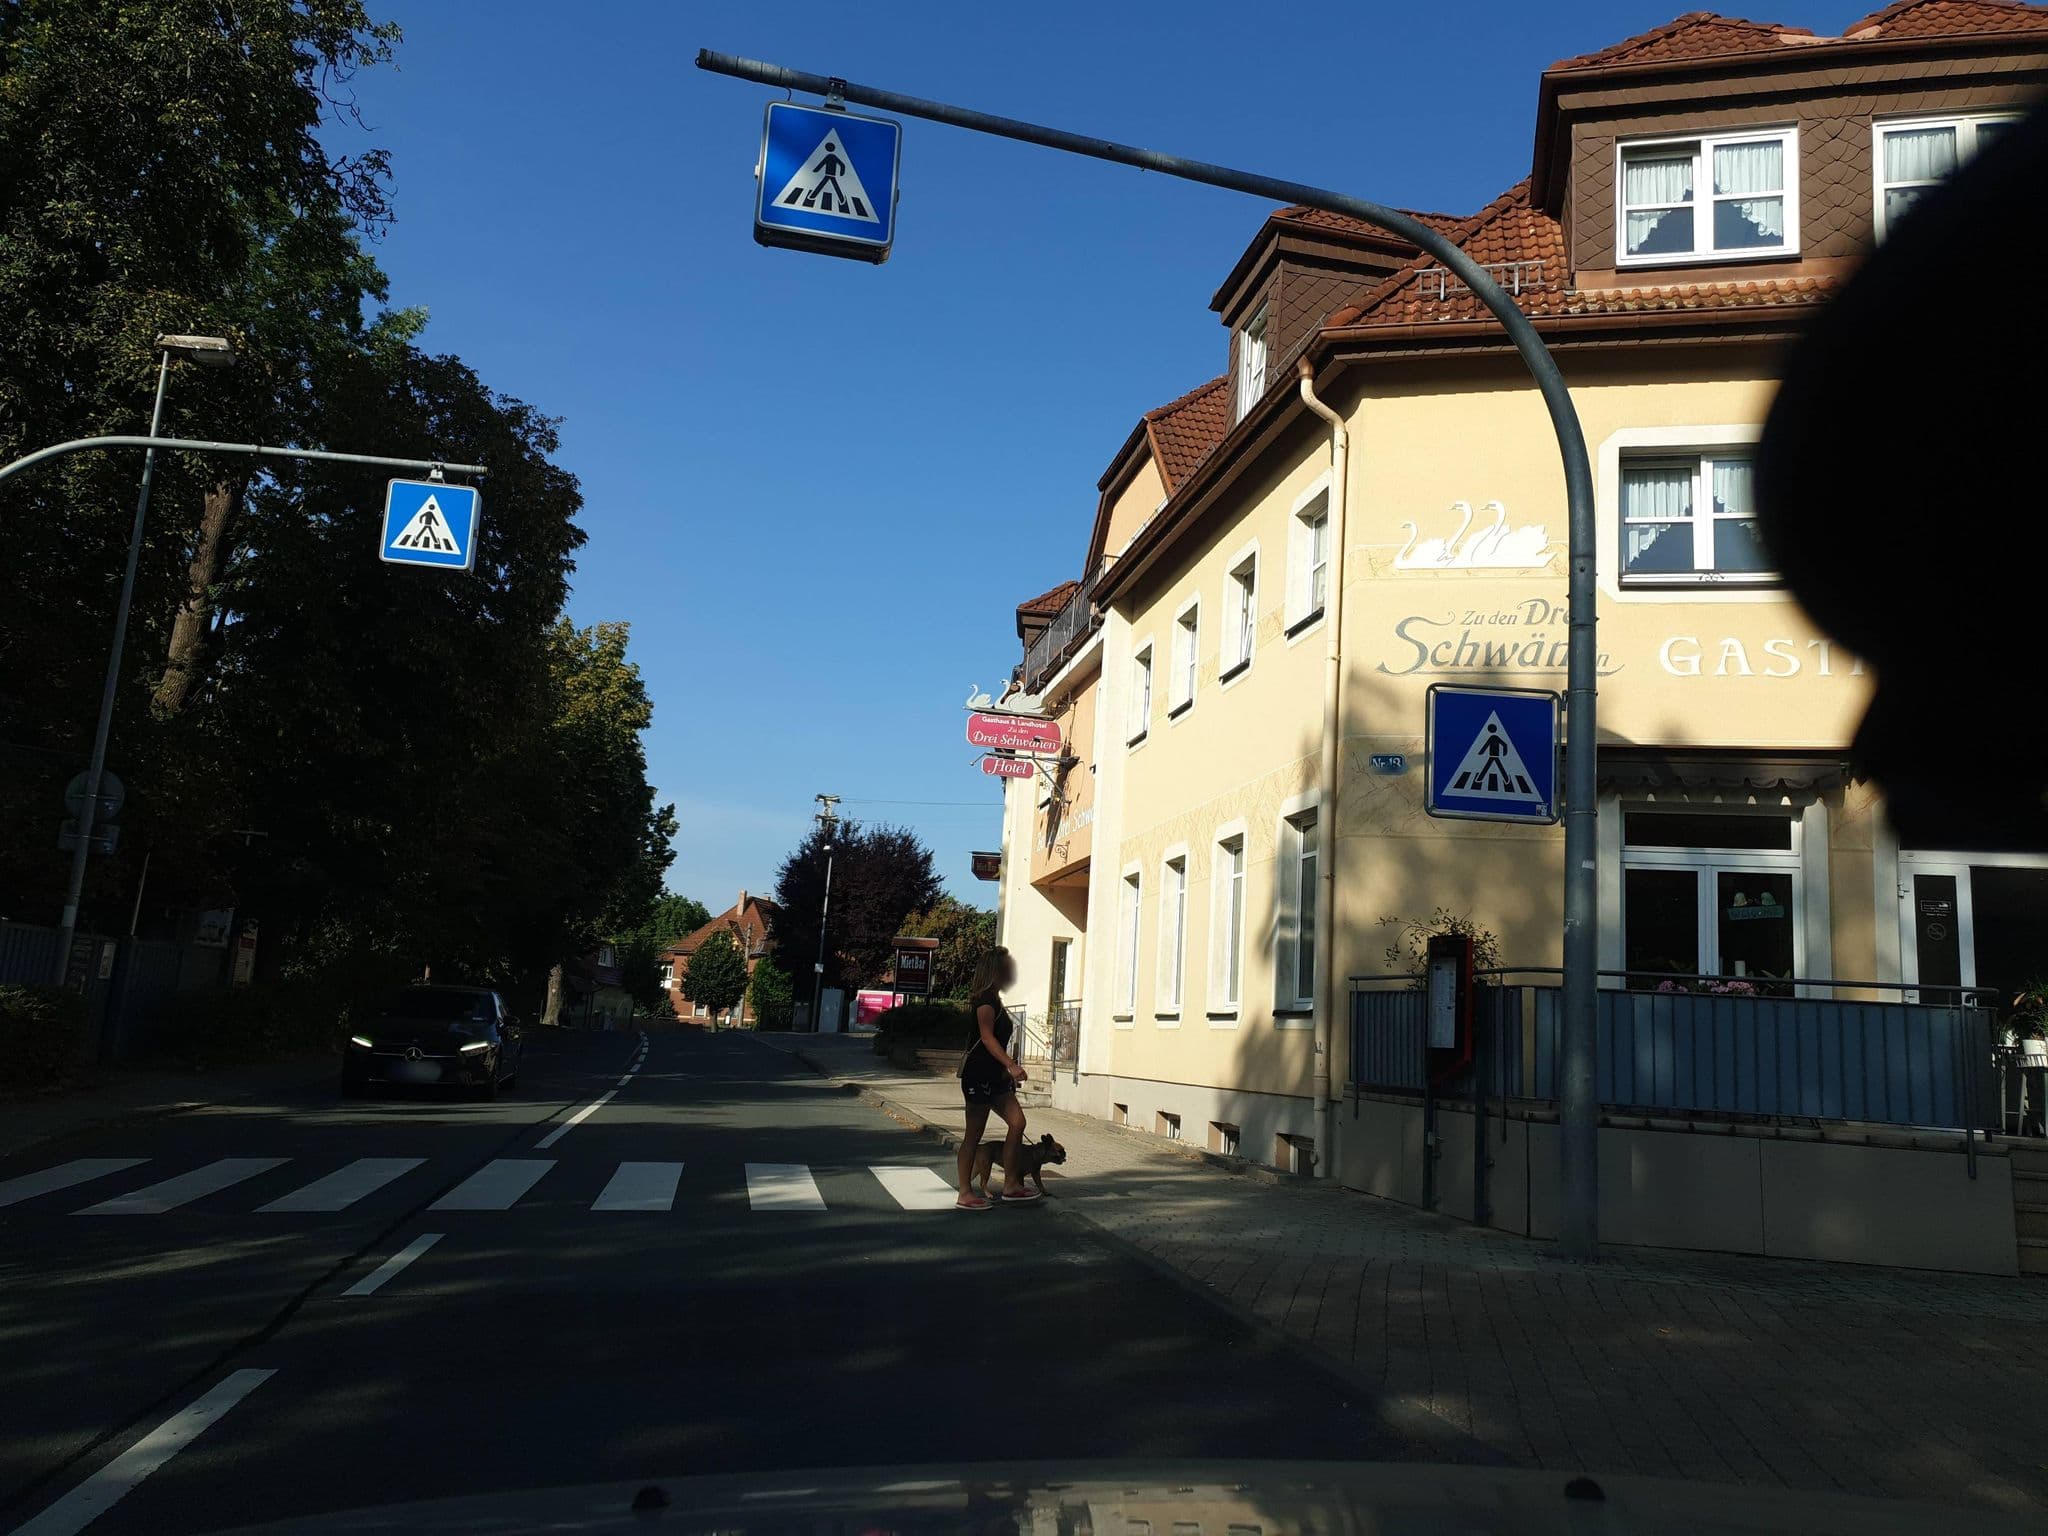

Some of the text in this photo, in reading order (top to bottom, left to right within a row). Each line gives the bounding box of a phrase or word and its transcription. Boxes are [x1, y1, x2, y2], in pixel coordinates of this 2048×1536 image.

[1460, 598, 1570, 625] Zu den Dre
[1375, 616, 1618, 676] Schwänn
[973, 730, 999, 744] Drei
[987, 760, 1028, 775] Hotel
